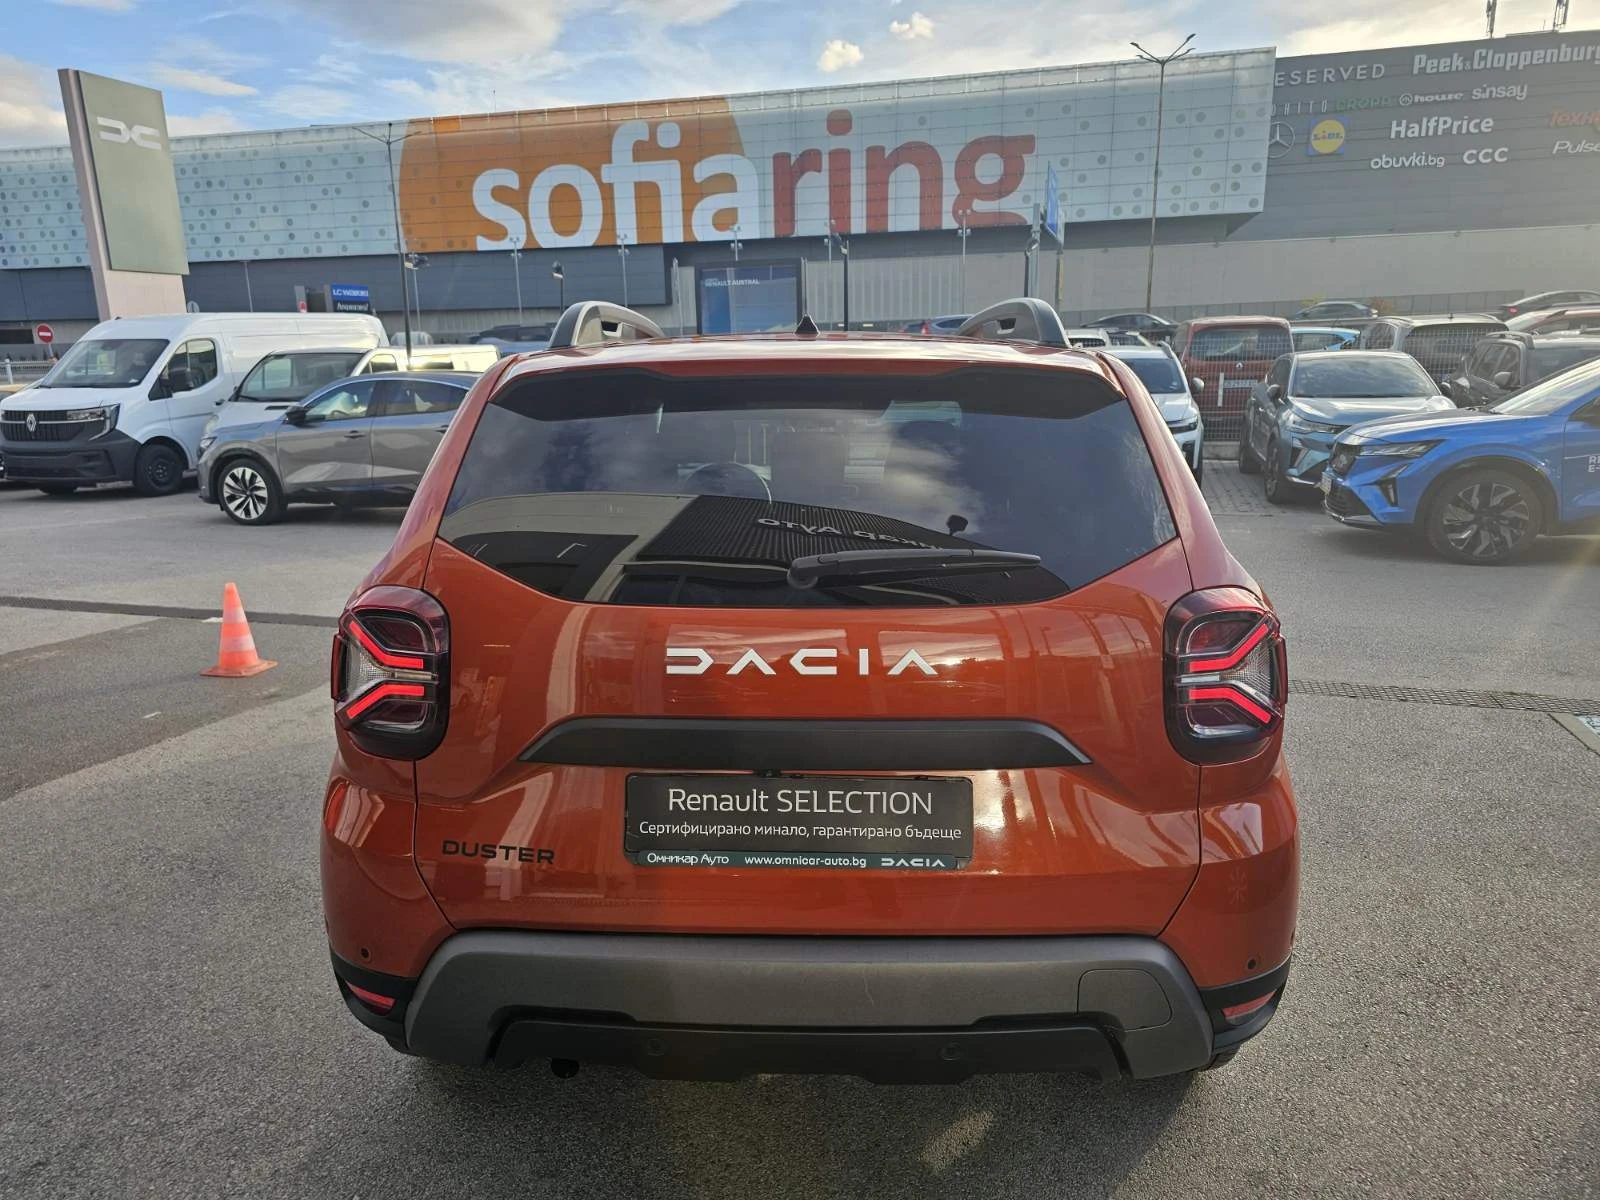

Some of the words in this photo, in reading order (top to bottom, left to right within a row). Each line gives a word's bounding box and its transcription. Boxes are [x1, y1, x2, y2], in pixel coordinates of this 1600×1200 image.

[1471, 84, 1528, 101] sinsay
[1390, 116, 1495, 140] HalfPrice
[1370, 152, 1446, 170] obuvki.bg
[1463, 147, 1509, 165] CCC
[665, 647, 939, 676] DACIA
[668, 788, 769, 812] Renault
[776, 789, 932, 815] SELECTION
[639, 821, 751, 837] Сертифицирано
[754, 825, 810, 838] минало,
[813, 826, 902, 840] гарантирано
[905, 825, 962, 841] бъдеще
[442, 840, 555, 865] DUSTER
[647, 852, 698, 866] Омникар
[701, 853, 730, 866] Ауто
[744, 855, 867, 868] www.omnicar-auto.bg
